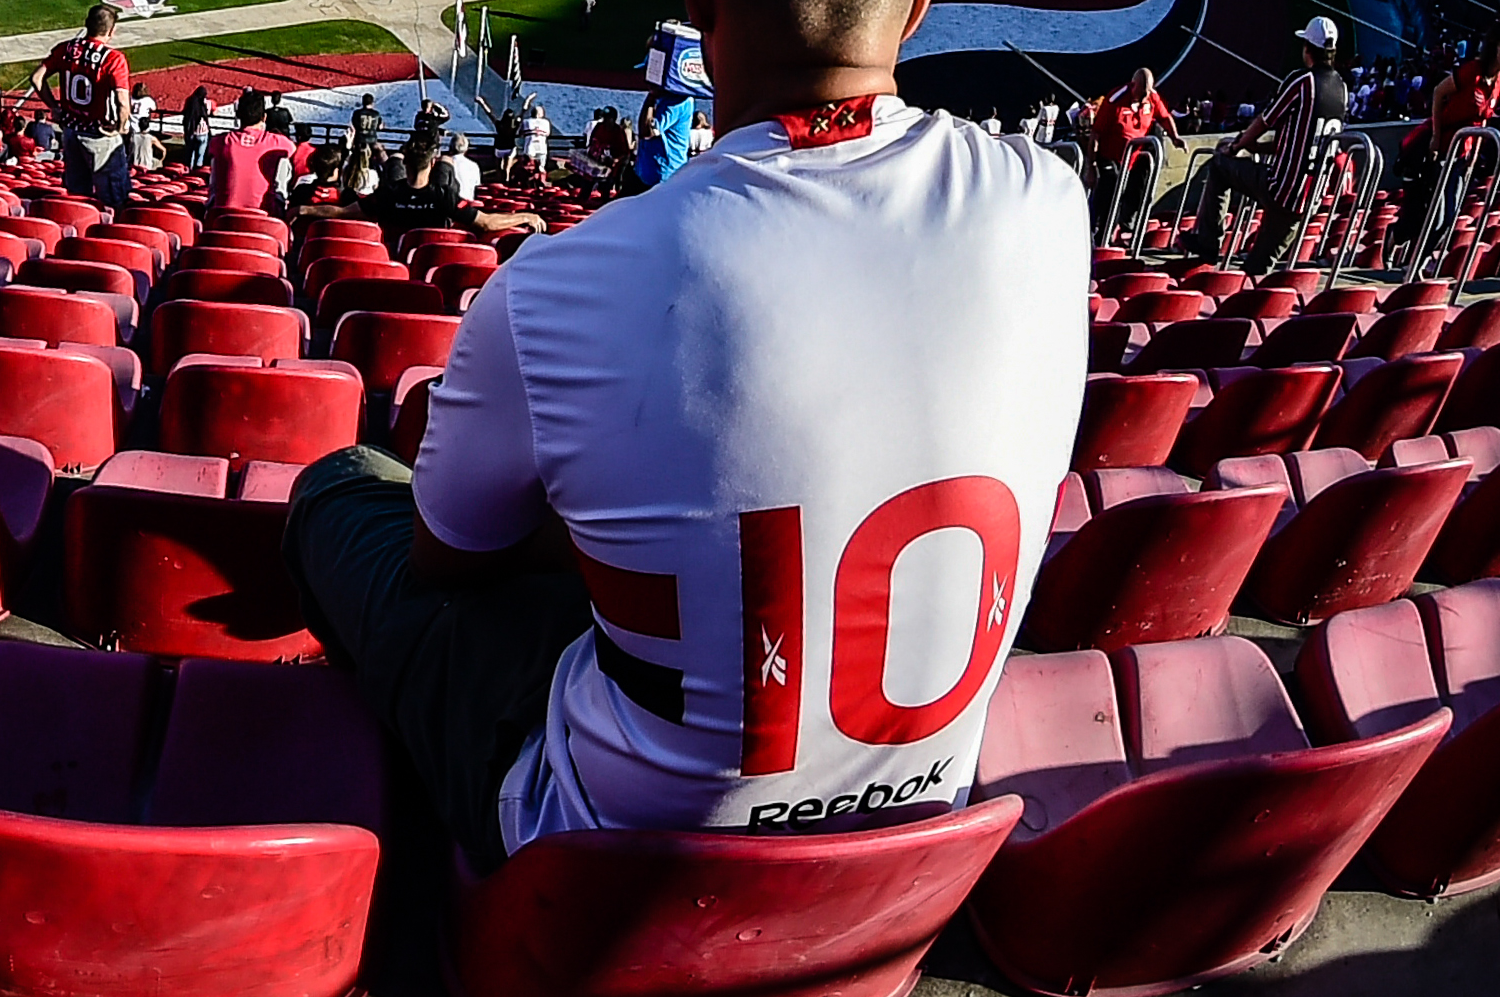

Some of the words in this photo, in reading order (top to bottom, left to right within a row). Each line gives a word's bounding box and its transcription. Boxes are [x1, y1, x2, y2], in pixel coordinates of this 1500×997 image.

[65, 69, 93, 106] 10
[739, 474, 1021, 777] 10
[747, 755, 955, 834] Reebok
